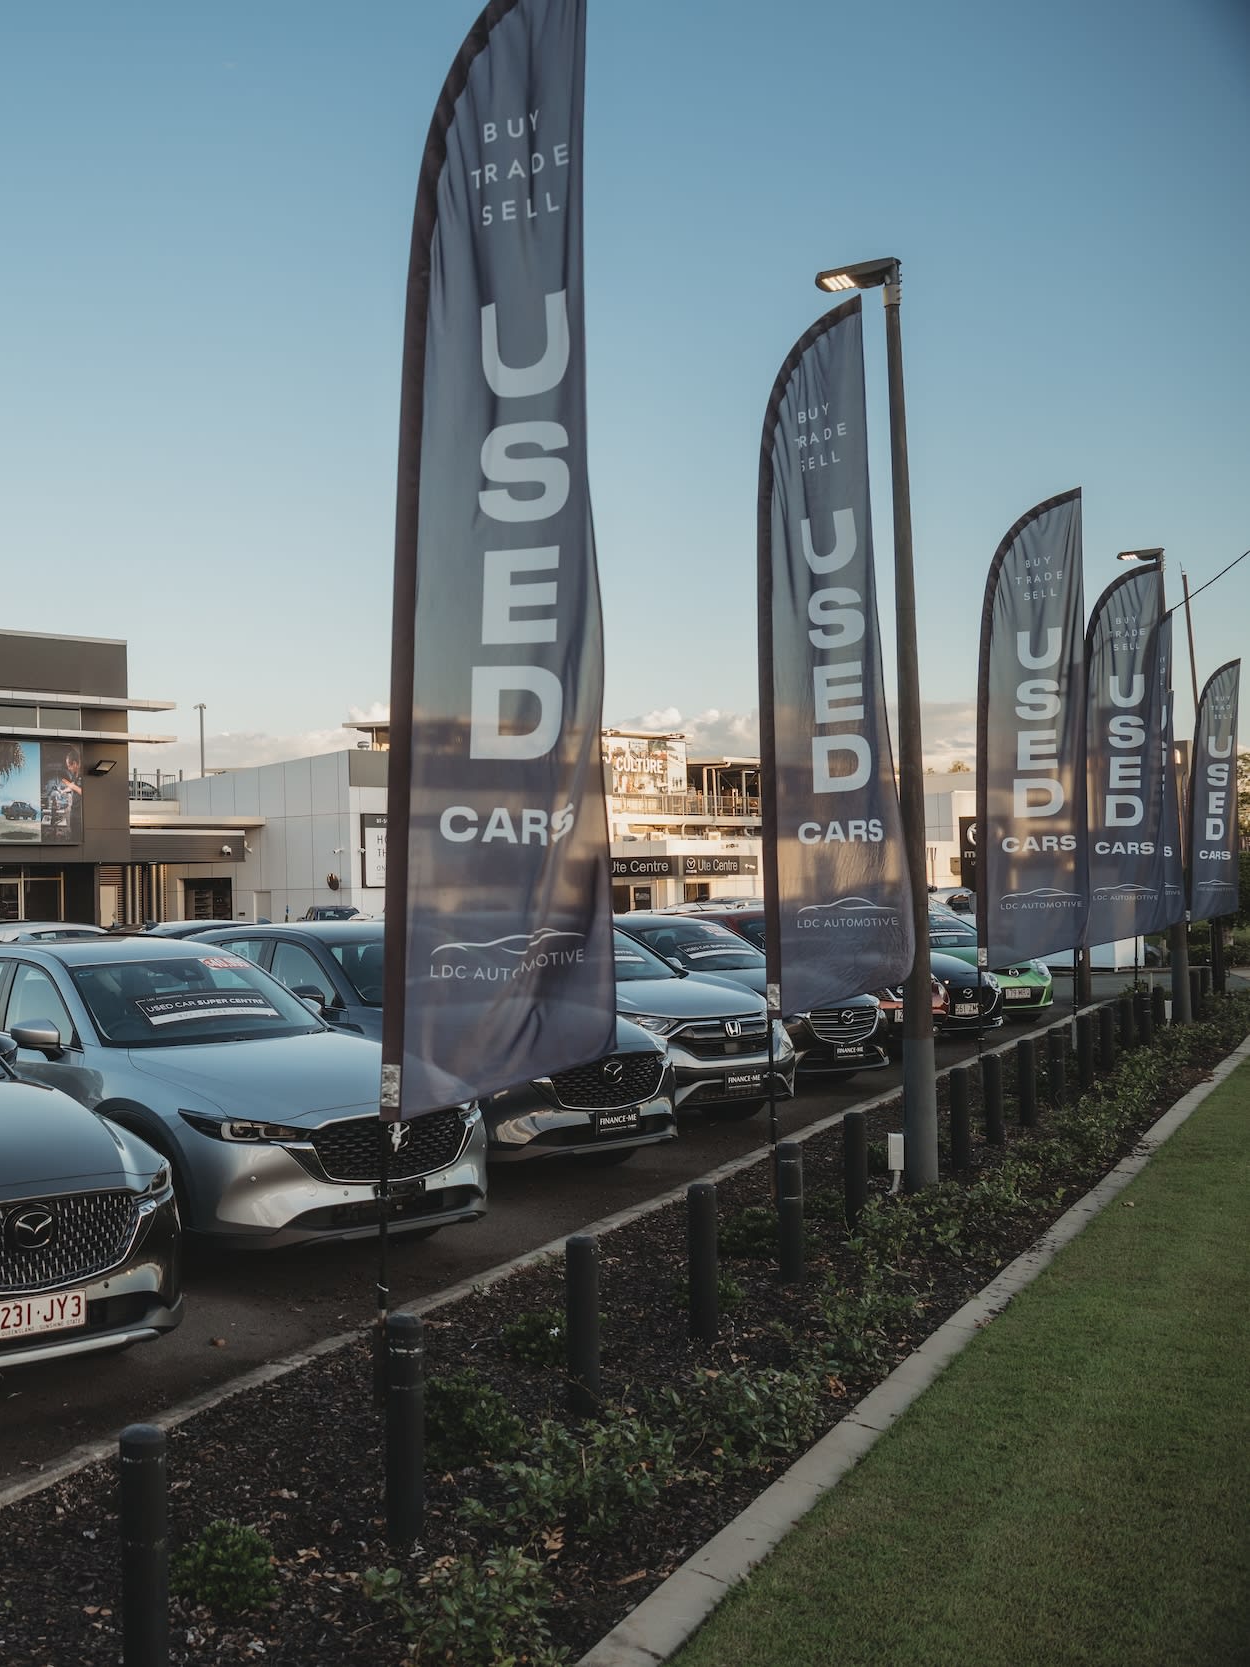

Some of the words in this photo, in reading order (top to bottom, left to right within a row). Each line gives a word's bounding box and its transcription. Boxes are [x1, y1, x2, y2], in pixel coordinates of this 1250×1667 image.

[483, 109, 539, 144] BUY
[471, 143, 569, 190] TRADE
[482, 192, 560, 226] SELL
[798, 403, 829, 424] BUY
[469, 288, 570, 760] USED
[1025, 556, 1051, 568] BUY
[1015, 570, 1062, 585] TRADE
[1024, 588, 1057, 600] SELL
[801, 507, 872, 794] USED
[1013, 627, 1064, 818] USED
[1105, 674, 1146, 827] USED
[616, 756, 664, 774] CULTURE
[1205, 735, 1233, 840] USED
[797, 819, 883, 845] CARS
[1002, 835, 1077, 853] CARS
[1095, 841, 1155, 855] CARS
[1199, 850, 1231, 861] CARS
[630, 860, 669, 873] Centre
[698, 859, 711, 871] Ute
[713, 859, 738, 871] Centre
[1000, 902, 1018, 910] LDC
[1021, 901, 1083, 909] AUTOMOTIVE
[797, 918, 820, 929] LDC
[824, 916, 899, 928] AUTOMOTIVE
[430, 964, 467, 979] LDC
[146, 1003, 174, 1013] USED
[174, 1000, 197, 1008] CAR
[197, 998, 227, 1006] SUPER
[727, 1074, 761, 1084] FINANCE-ME
[600, 1113, 637, 1126] FINANCE-ME
